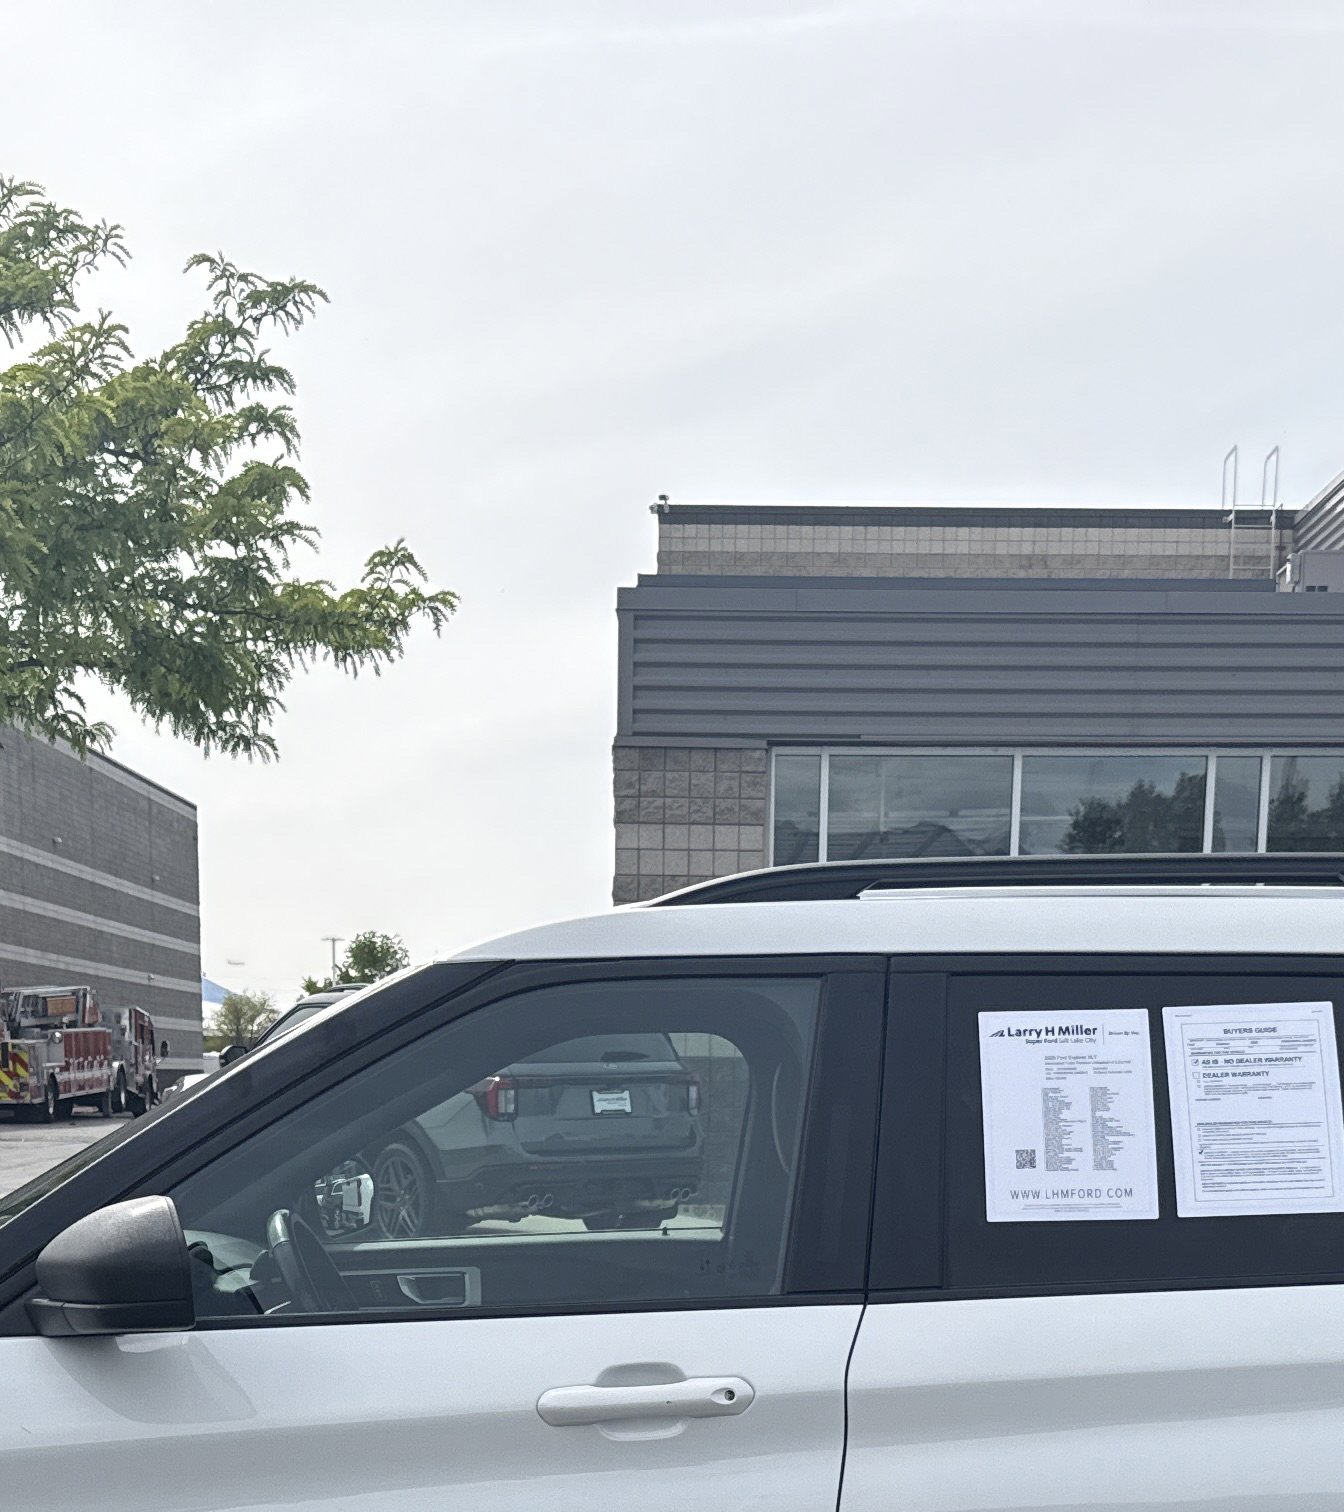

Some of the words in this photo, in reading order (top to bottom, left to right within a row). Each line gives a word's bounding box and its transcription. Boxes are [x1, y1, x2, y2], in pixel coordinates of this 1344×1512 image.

[1007, 1026, 1043, 1038] Larry
[1045, 1026, 1055, 1037] H
[1057, 1025, 1098, 1036] Miller
